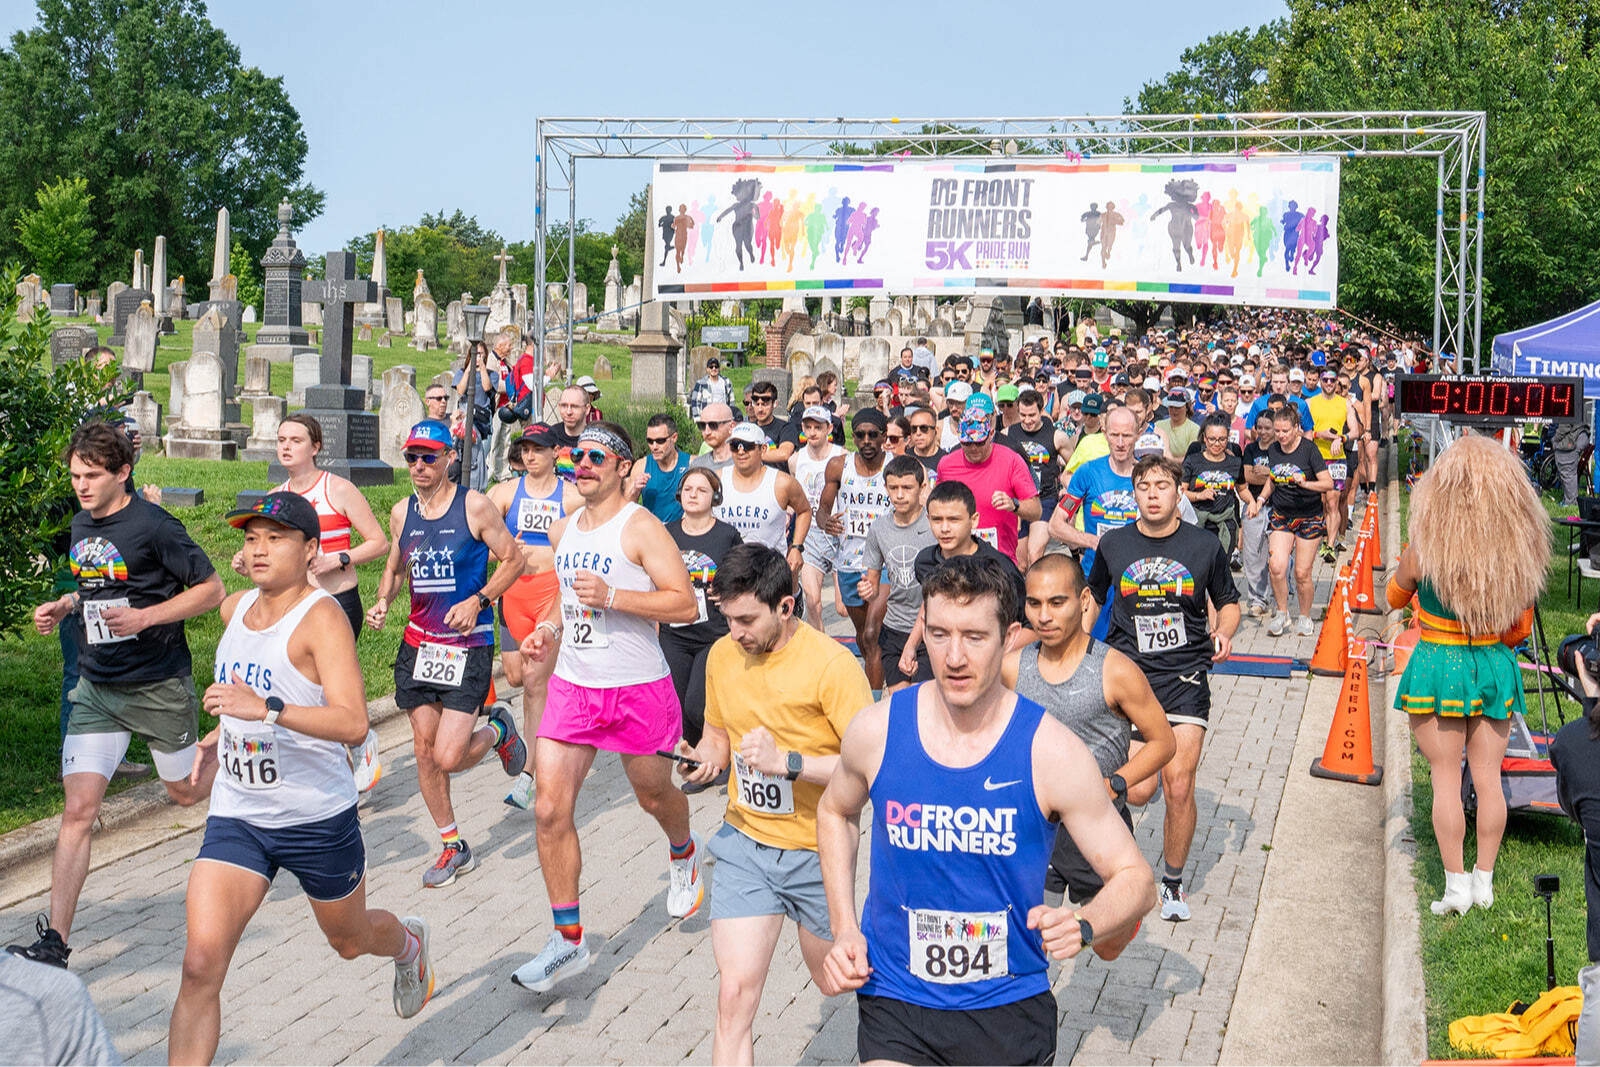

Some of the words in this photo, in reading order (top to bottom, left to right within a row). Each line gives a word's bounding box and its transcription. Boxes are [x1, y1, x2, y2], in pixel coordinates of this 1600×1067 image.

[930, 178, 958, 206] DC
[961, 178, 1035, 207] FRONT
[927, 208, 1032, 239] RUNNERS
[925, 241, 974, 270] 5K
[976, 241, 1006, 259] PRIDE
[1007, 241, 1030, 259] RUN
[524, 513, 552, 529] 920
[721, 505, 769, 520] PACERS
[412, 562, 429, 578] dc
[433, 561, 454, 578] tri
[557, 552, 612, 574] PACERS
[573, 622, 593, 644] 32
[1145, 628, 1179, 649] 799
[214, 662, 272, 691] ACES
[422, 660, 456, 682] 326
[223, 752, 278, 784] 1416
[742, 778, 782, 809] 569
[886, 823, 1017, 856] RUNNERS
[544, 948, 578, 976] BROOKS
[925, 944, 992, 978] 894
